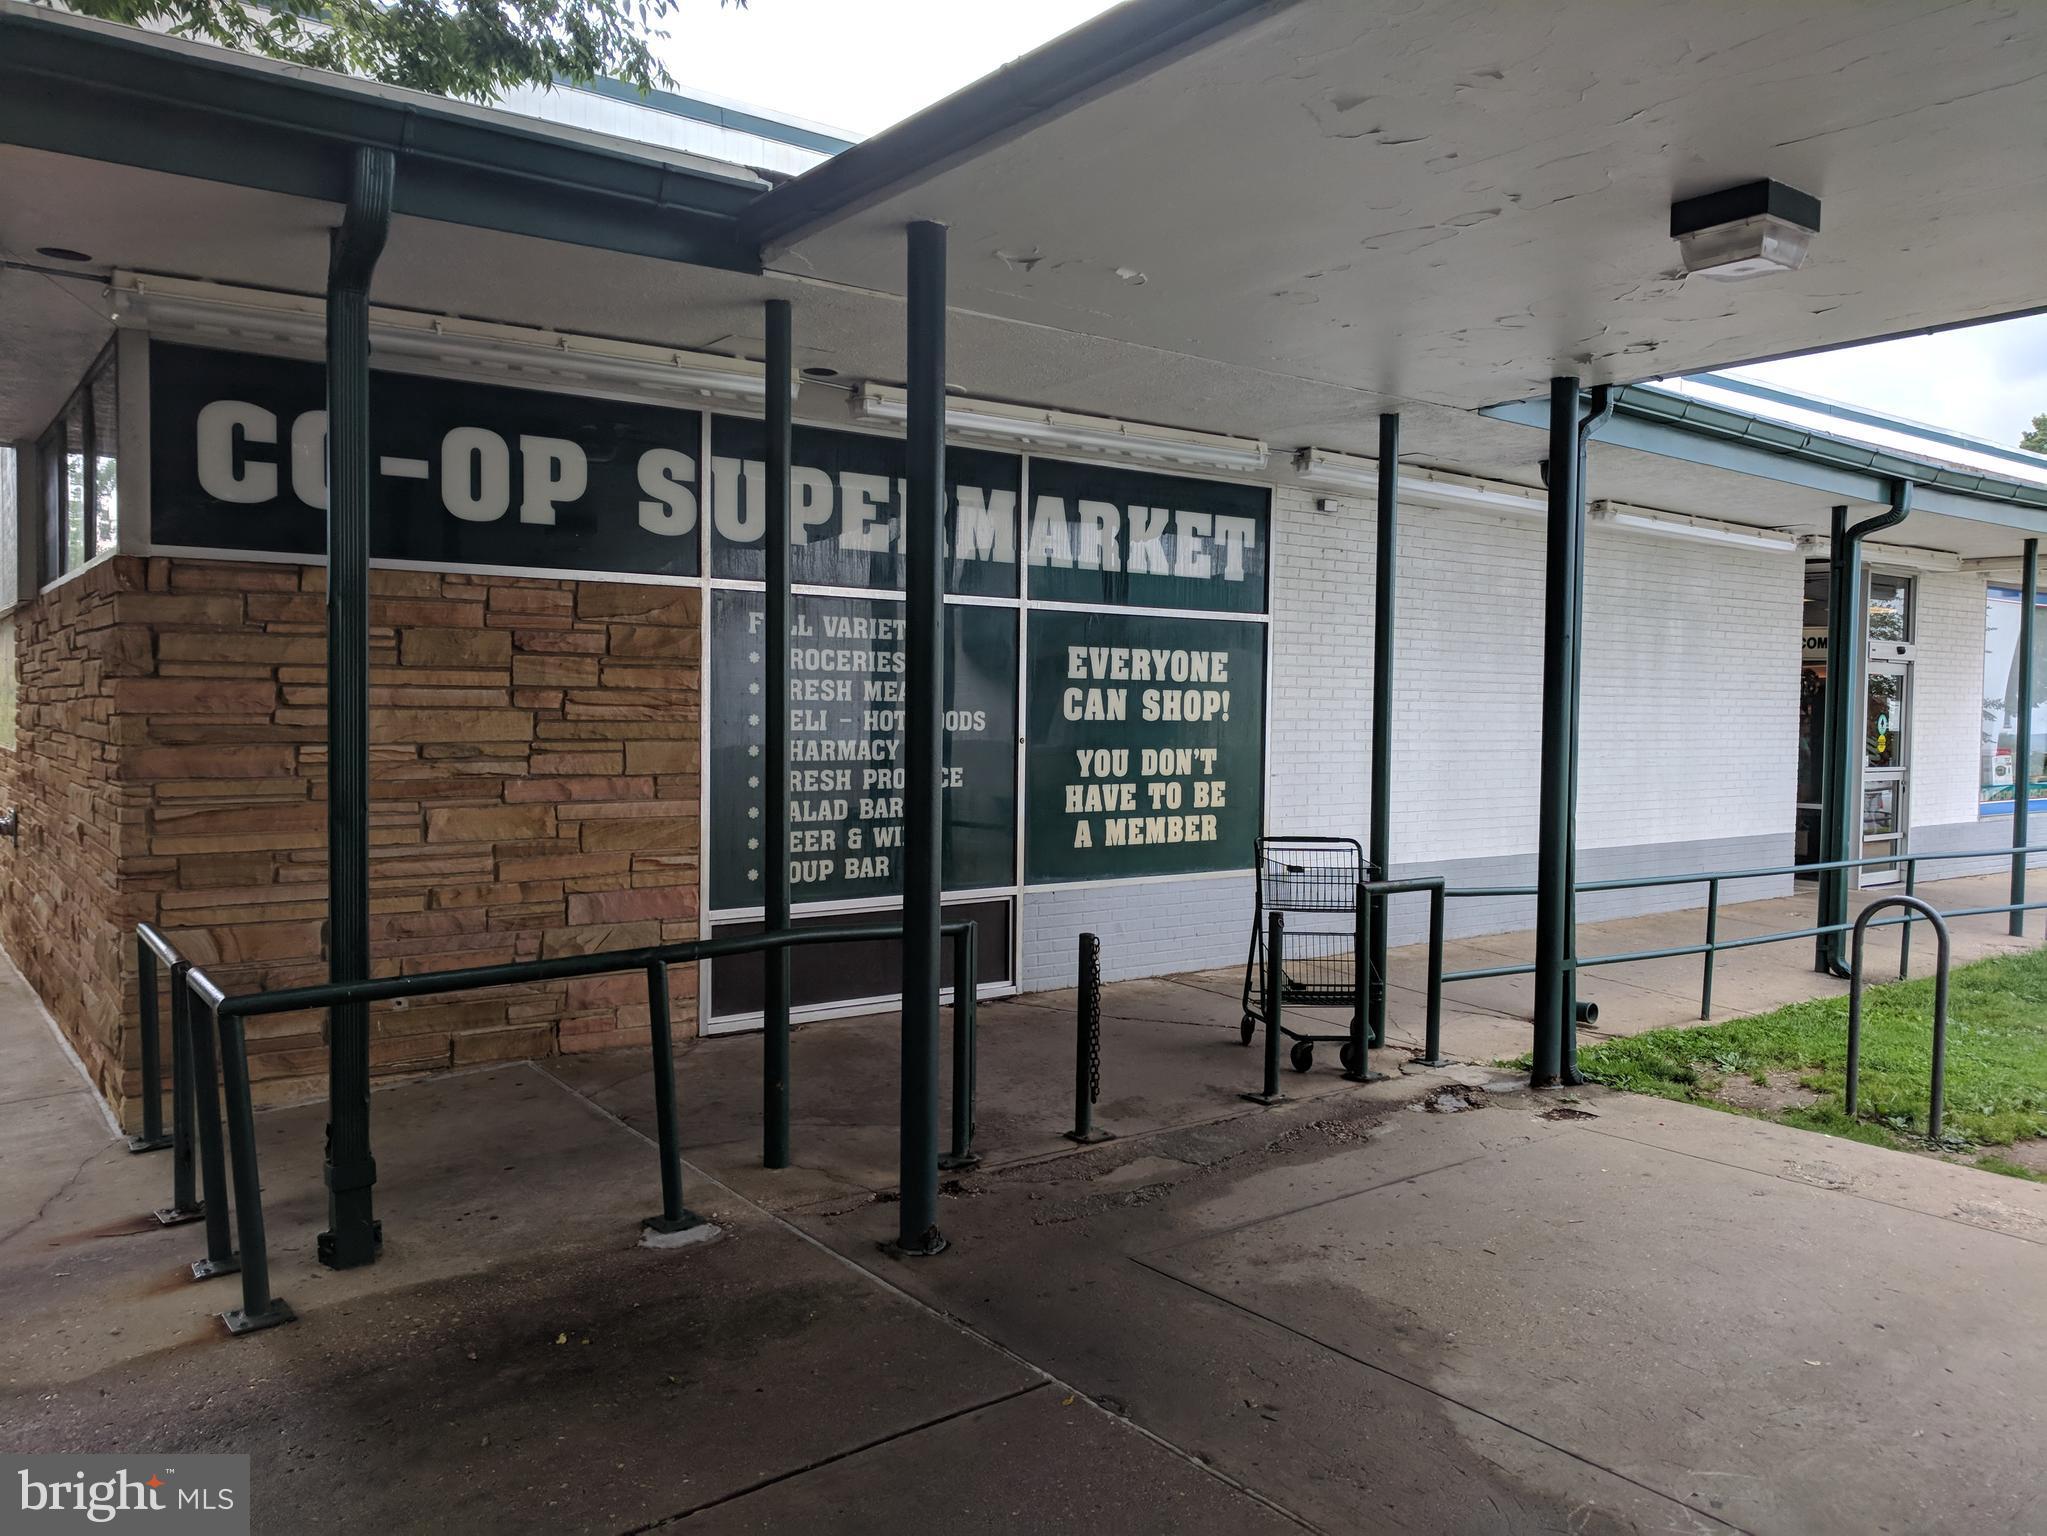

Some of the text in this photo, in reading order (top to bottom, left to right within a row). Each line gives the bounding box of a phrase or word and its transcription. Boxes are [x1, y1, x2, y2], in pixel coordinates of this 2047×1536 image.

[637, 448, 1256, 581] SUPEMARKET
[748, 612, 906, 640] FL VARIET
[790, 648, 906, 673] ROCERIES
[1067, 646, 1229, 683] EVERYONE
[790, 679, 852, 702] RESH
[1063, 687, 1231, 722] CAN SHOP!
[790, 710, 828, 731] ELI
[790, 739, 901, 761] HARMACY
[1076, 748, 1218, 777] YOU DON'T
[790, 767, 964, 792] RESH PROCE
[790, 797, 904, 822] ALAD BAR
[1065, 781, 1226, 813] HAVE TO BE
[790, 830, 836, 852] EER
[847, 828, 863, 849] &
[1074, 814, 1218, 848] A MEMBER
[790, 856, 890, 884] OUP BAR
